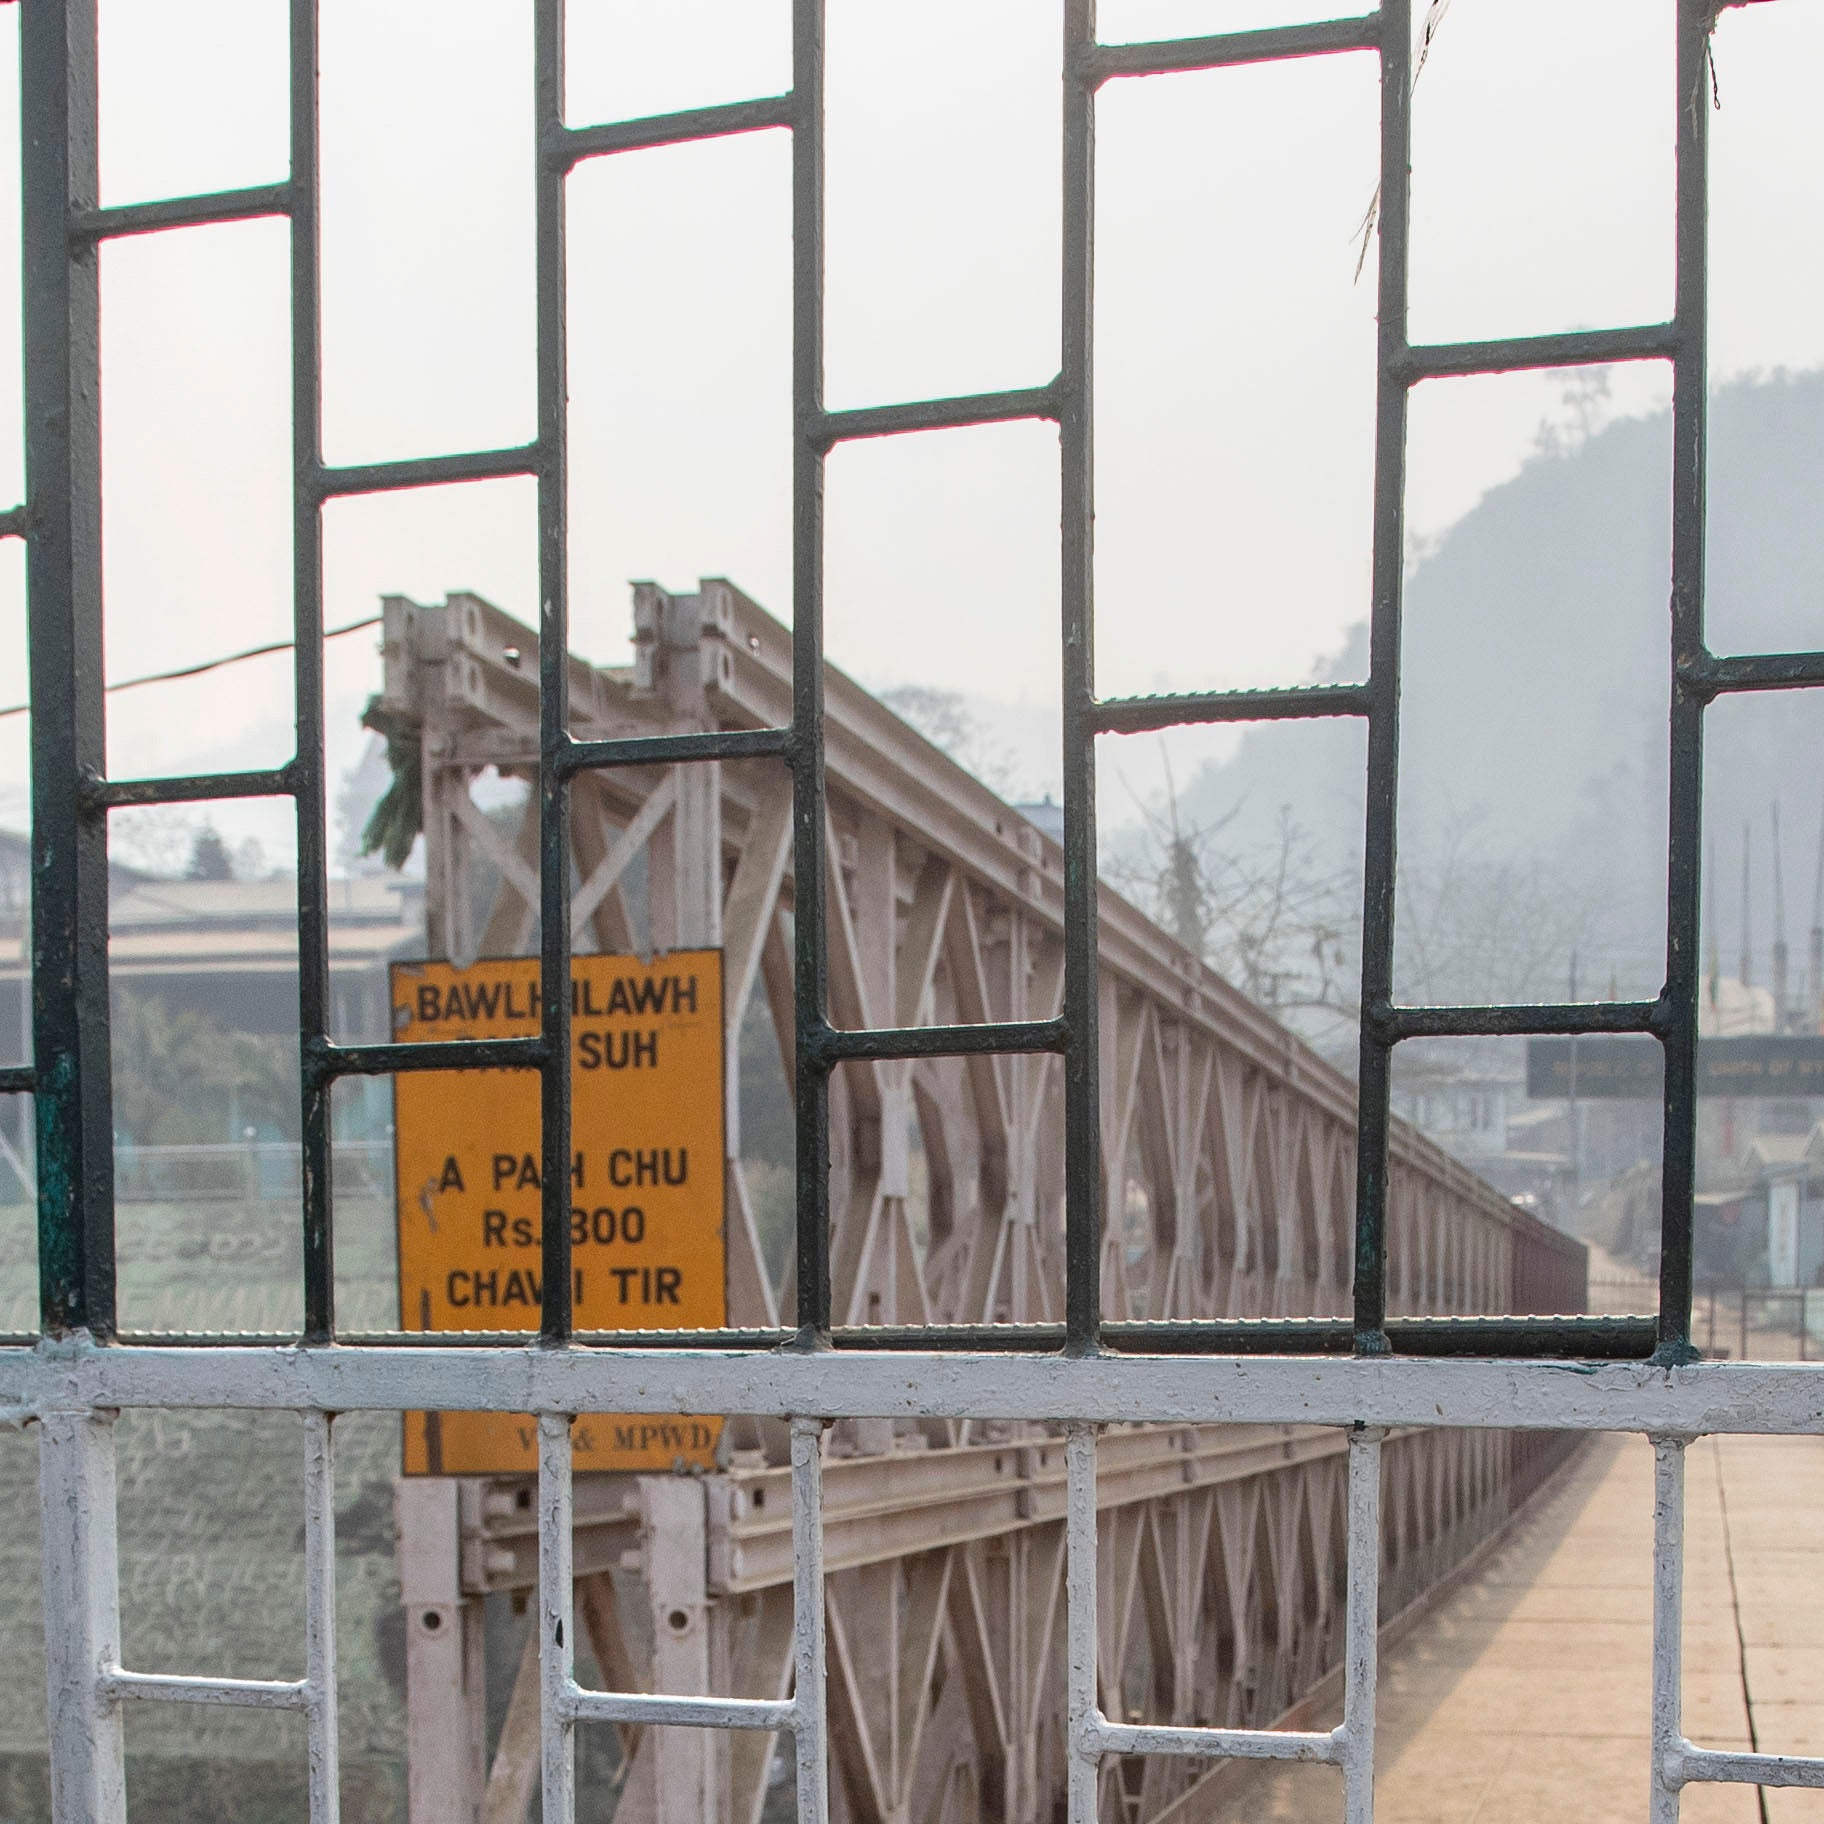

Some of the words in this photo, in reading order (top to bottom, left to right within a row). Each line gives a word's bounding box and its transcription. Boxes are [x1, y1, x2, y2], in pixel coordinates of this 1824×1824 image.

[417, 974, 698, 1022] BAWLHLAWH
[578, 1030, 659, 1069] SUH
[439, 1156, 465, 1193] A
[493, 1153, 585, 1191] PAH
[608, 1148, 688, 1188] CHU
[610, 1267, 682, 1305] TIR
[614, 1423, 713, 1450] MPWD
